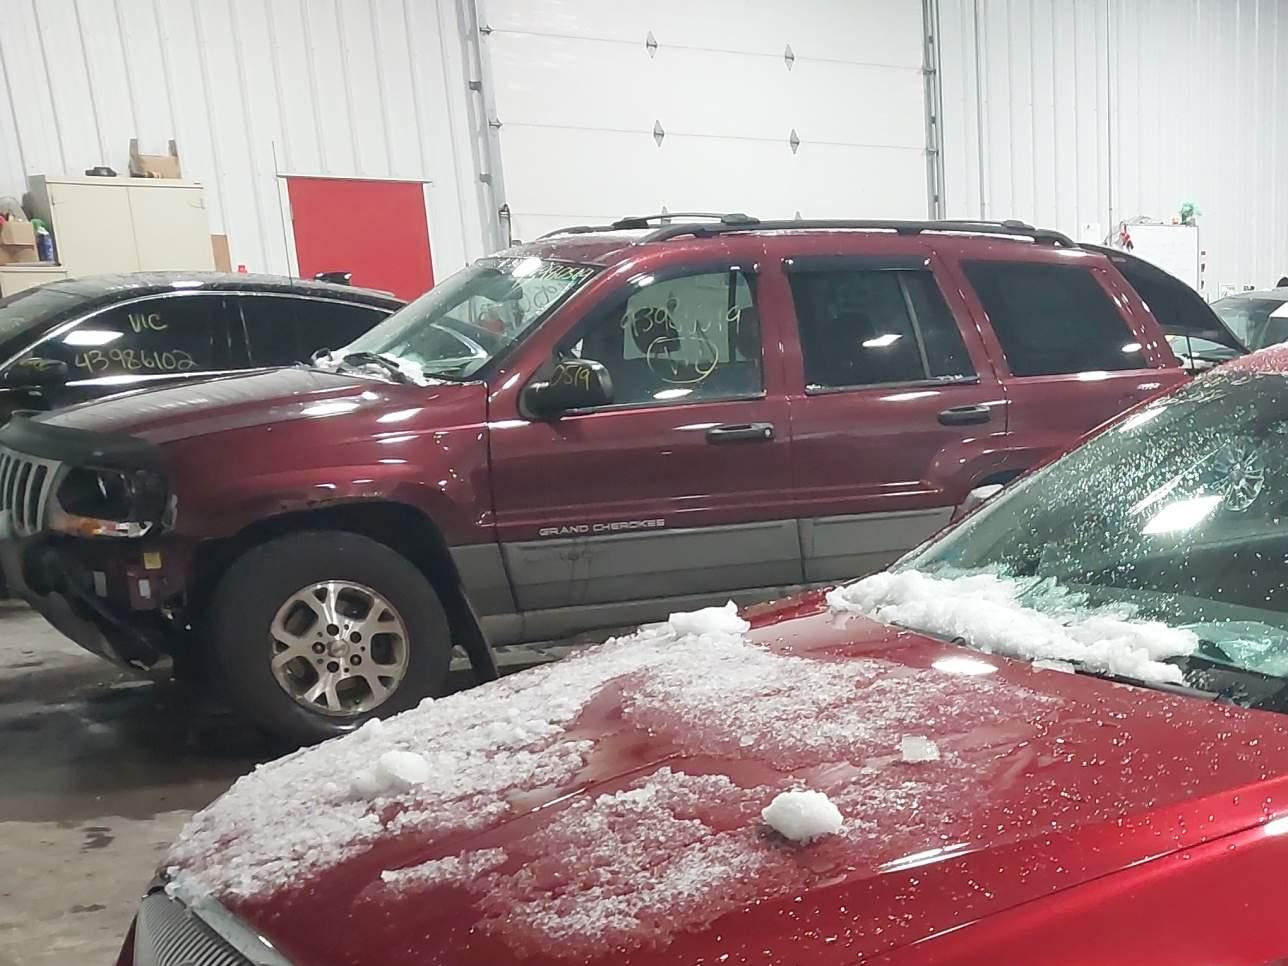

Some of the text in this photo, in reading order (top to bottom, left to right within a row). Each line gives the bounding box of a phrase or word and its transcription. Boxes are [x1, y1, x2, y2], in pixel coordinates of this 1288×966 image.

[75, 348, 198, 373] 43986102
[538, 518, 665, 537] GRAND CHEROKEE
